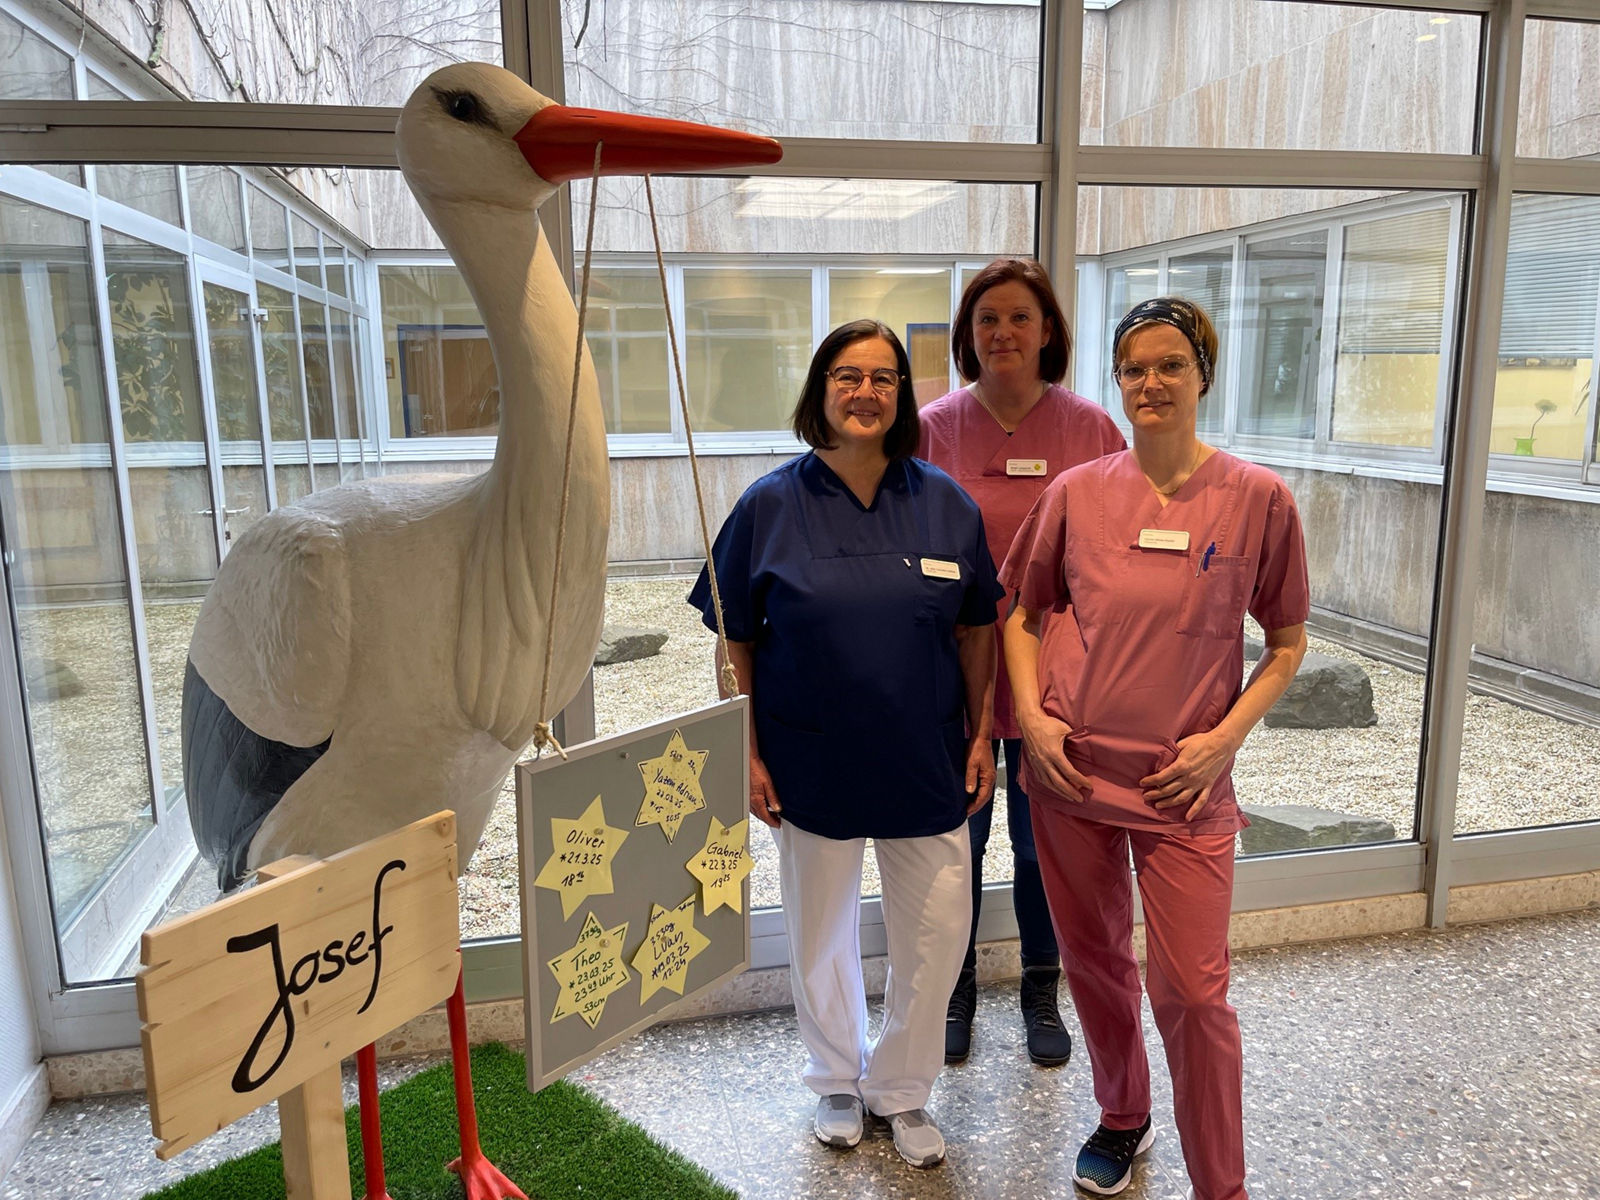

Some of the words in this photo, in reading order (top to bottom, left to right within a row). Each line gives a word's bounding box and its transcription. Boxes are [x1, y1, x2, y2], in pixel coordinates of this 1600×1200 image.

[566, 829, 605, 849] Oliver
[707, 841, 744, 860] Gabriel
[653, 931, 684, 961] Luan
[571, 948, 601, 972] Theo
[226, 859, 407, 1094] Josef
[599, 972, 616, 987] Uhr
[583, 997, 606, 1014] 53cm
